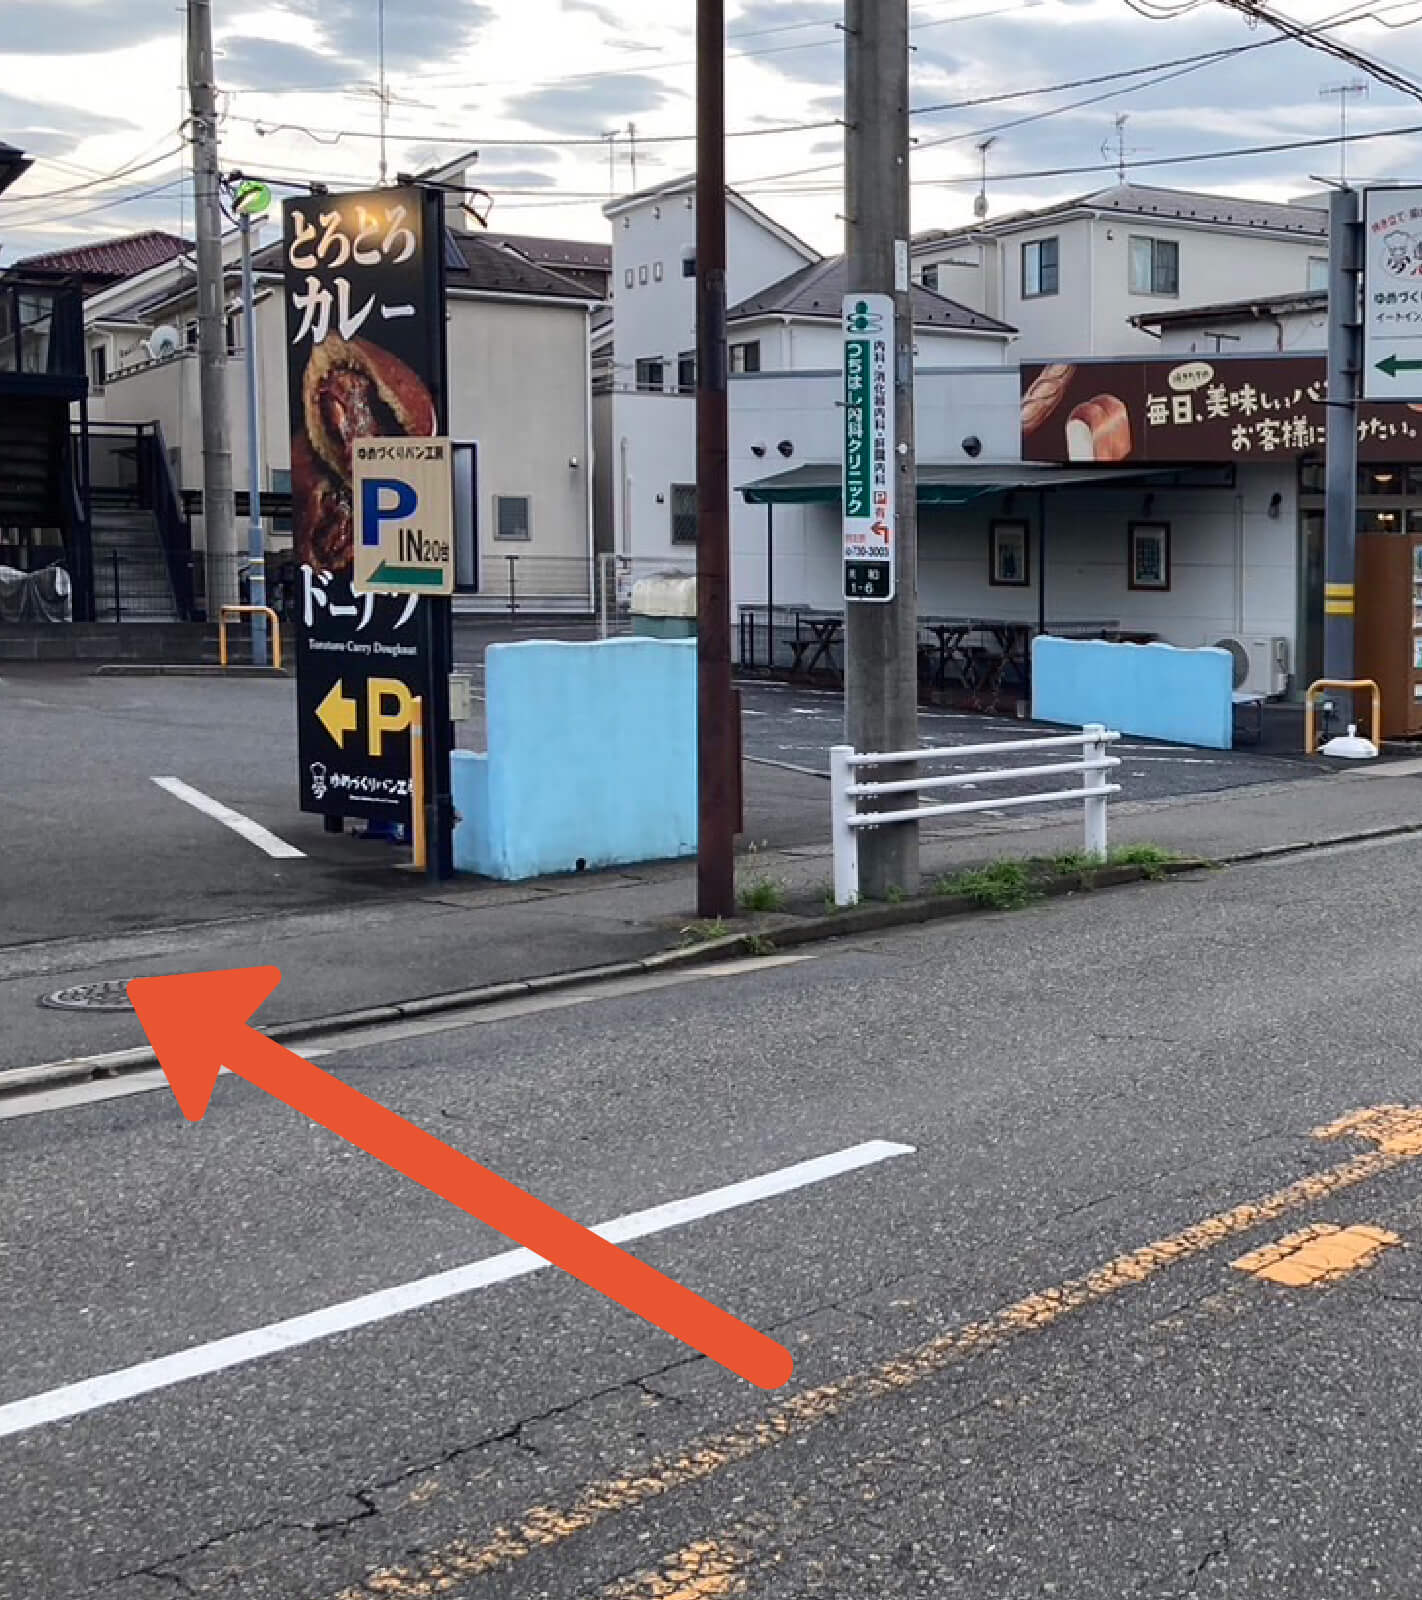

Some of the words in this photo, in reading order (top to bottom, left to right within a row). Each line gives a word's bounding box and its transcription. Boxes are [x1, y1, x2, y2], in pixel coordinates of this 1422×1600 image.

[289, 204, 417, 270] とろとろ
[292, 275, 417, 345] カレー
[1146, 379, 1331, 425] 毎日、美味しいパ
[357, 446, 443, 460] ゆめづくりパン工房
[1230, 415, 1417, 452] お客様にけたい。
[361, 478, 418, 546] P
[399, 527, 423, 562] IN
[366, 677, 414, 757] P
